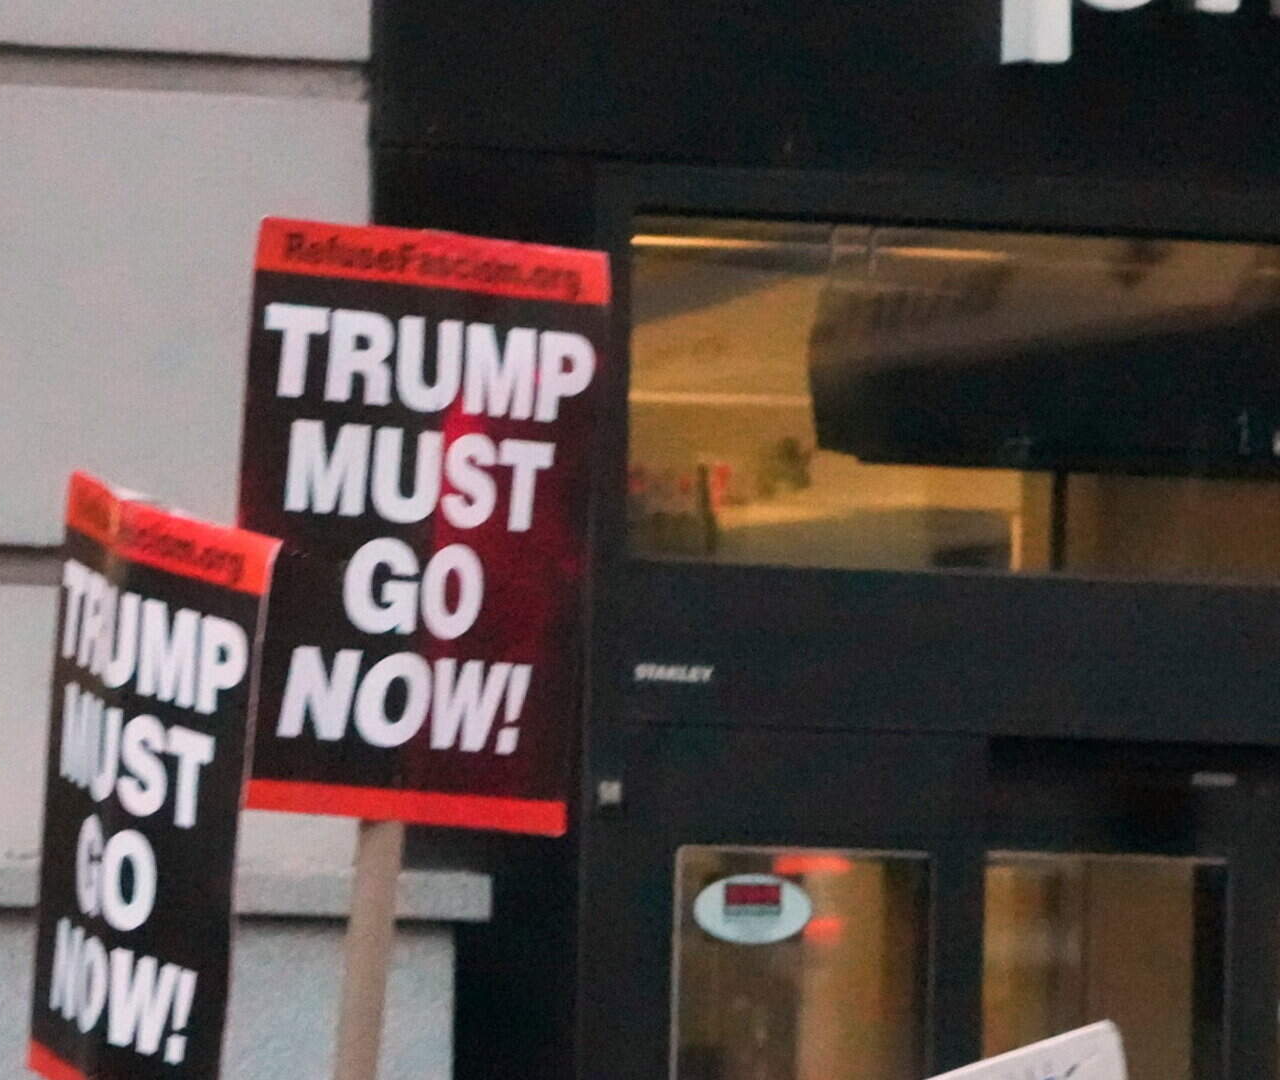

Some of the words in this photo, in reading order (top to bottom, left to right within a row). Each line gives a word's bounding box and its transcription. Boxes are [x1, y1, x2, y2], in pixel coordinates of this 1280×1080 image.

[265, 302, 595, 422] TRUMP
[284, 419, 555, 532] MUST
[62, 558, 248, 714] TRUMP
[343, 537, 485, 640] GO
[61, 682, 216, 828] MUST
[277, 645, 532, 755] NOW!
[76, 813, 157, 931] GO
[49, 917, 198, 1066] NOW!
